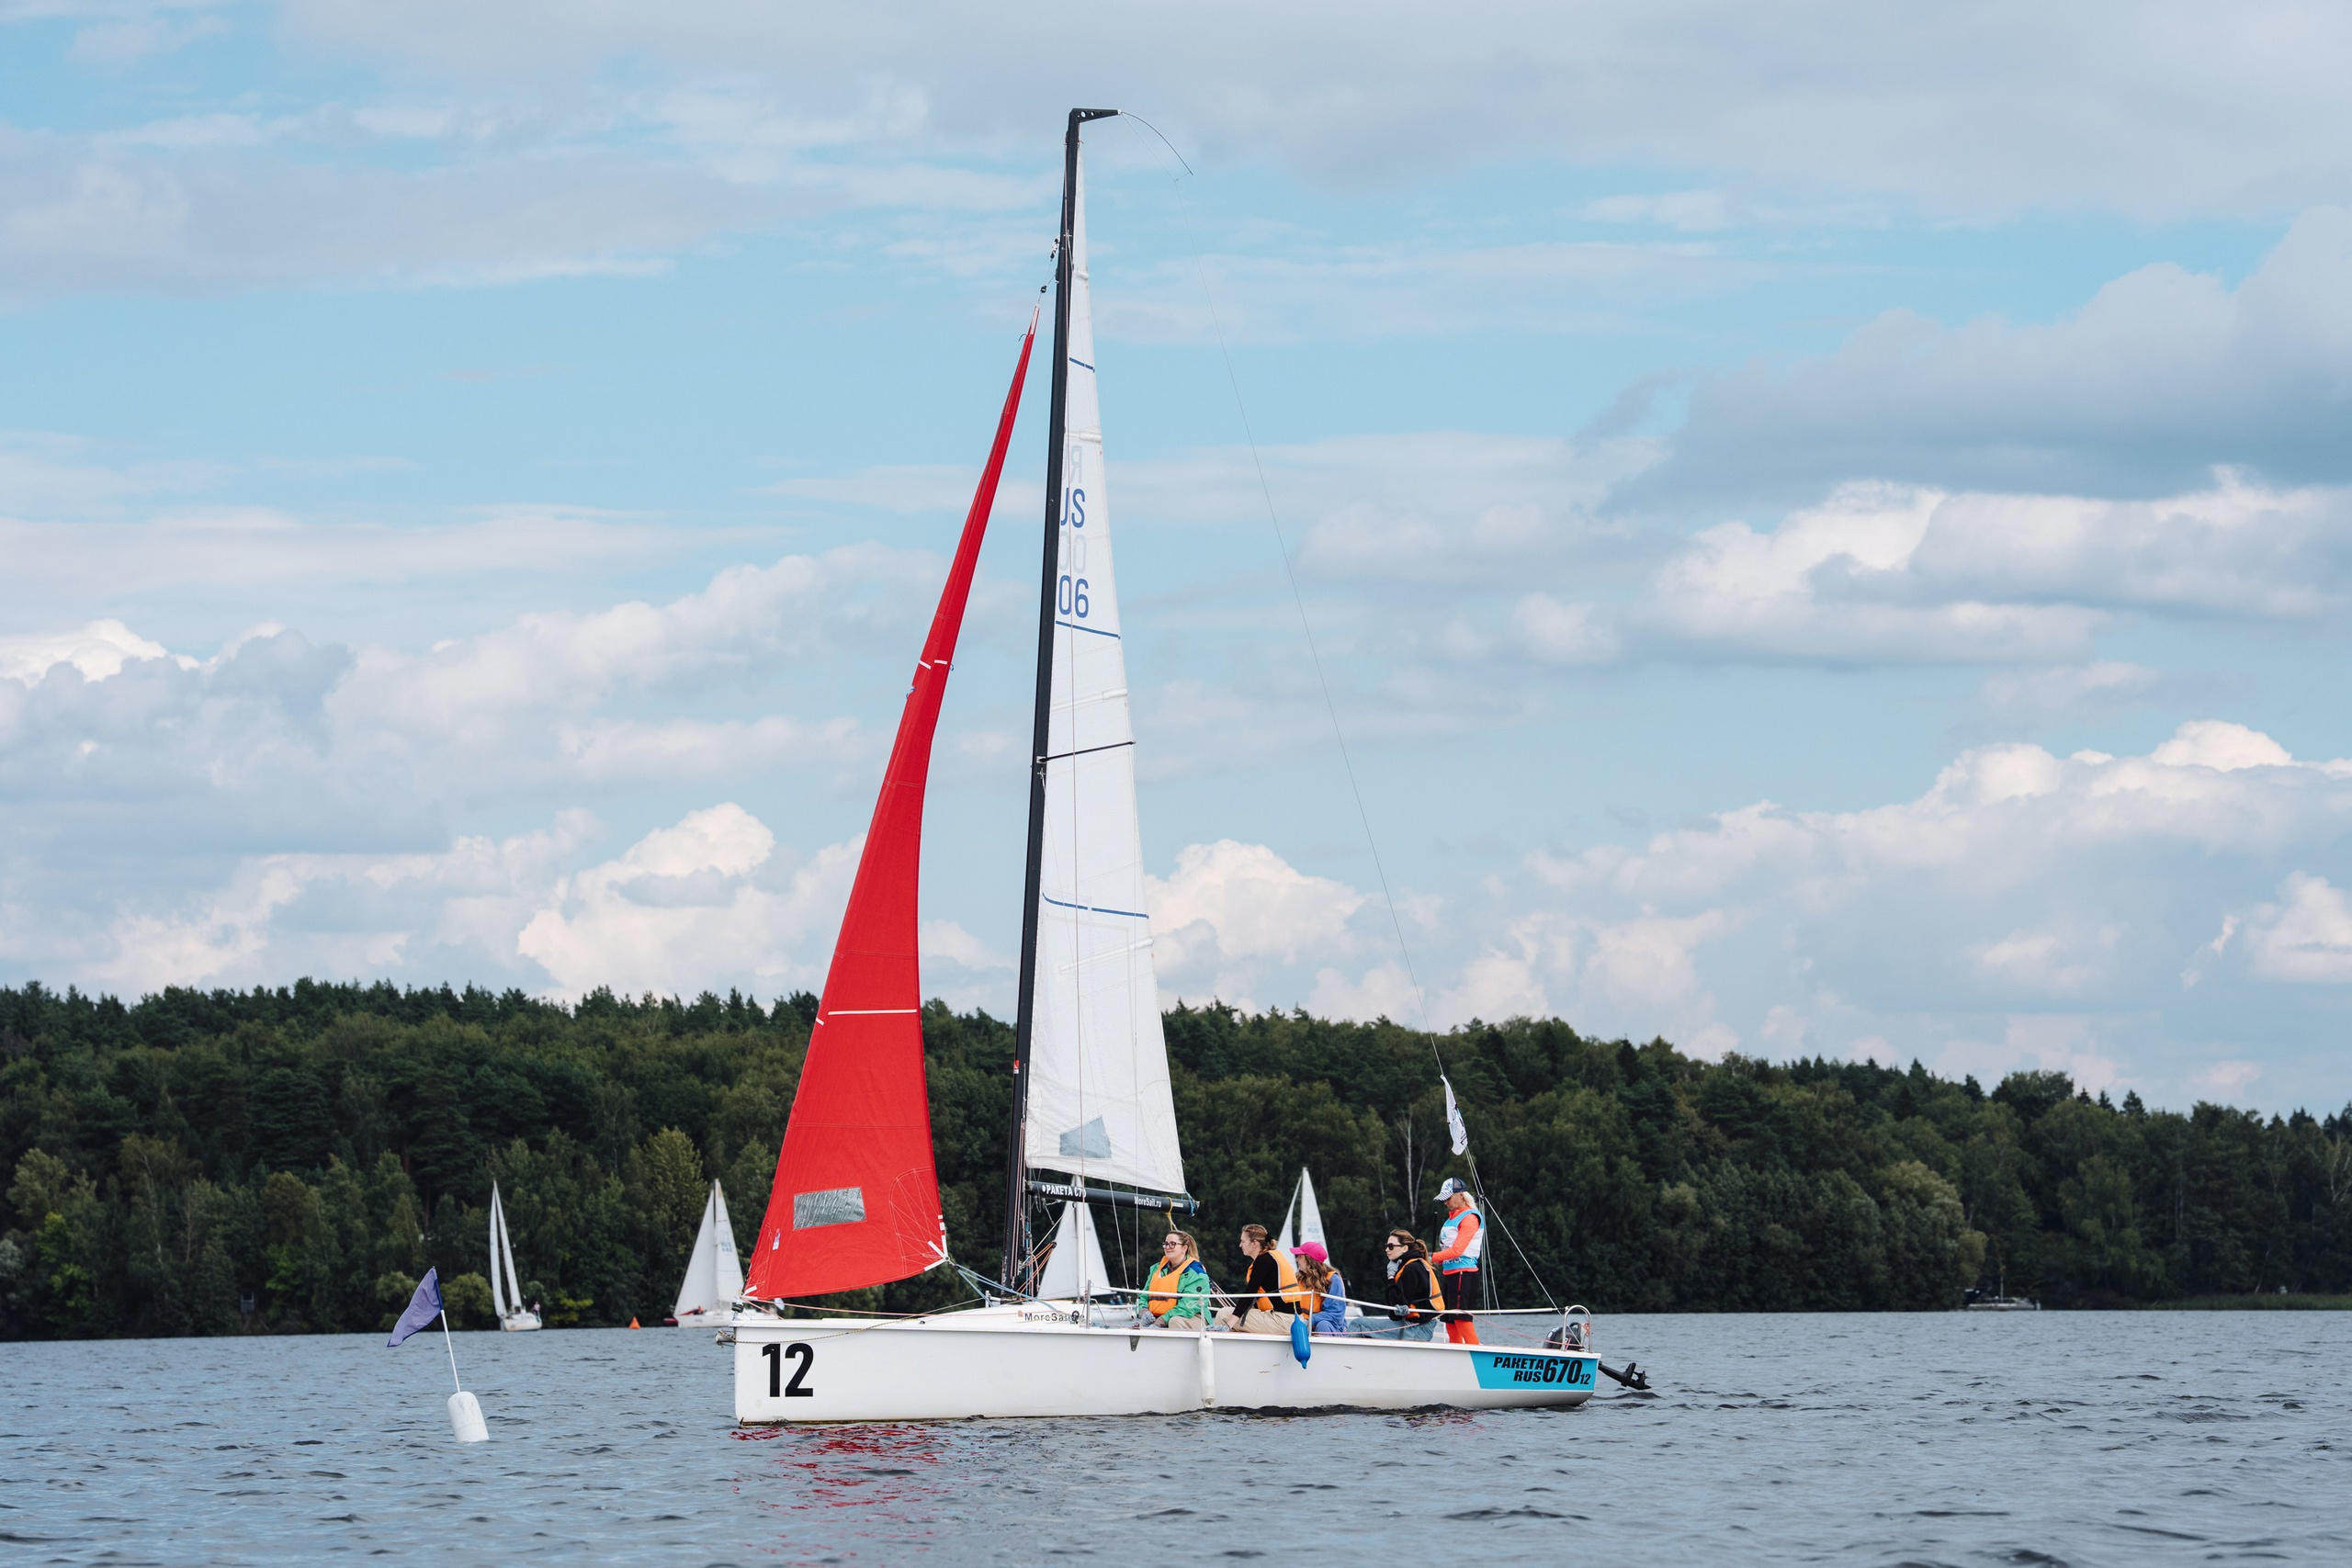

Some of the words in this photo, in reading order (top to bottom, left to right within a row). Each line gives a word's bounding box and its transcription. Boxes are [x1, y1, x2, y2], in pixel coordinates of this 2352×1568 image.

[1058, 574, 1090, 618] 06
[1134, 1195, 1162, 1208] MoreSail.ru
[762, 1342, 814, 1398] 12
[1513, 1370, 1543, 1382] RUS
[1543, 1358, 1583, 1384] 670
[1579, 1373, 1591, 1385] 12
